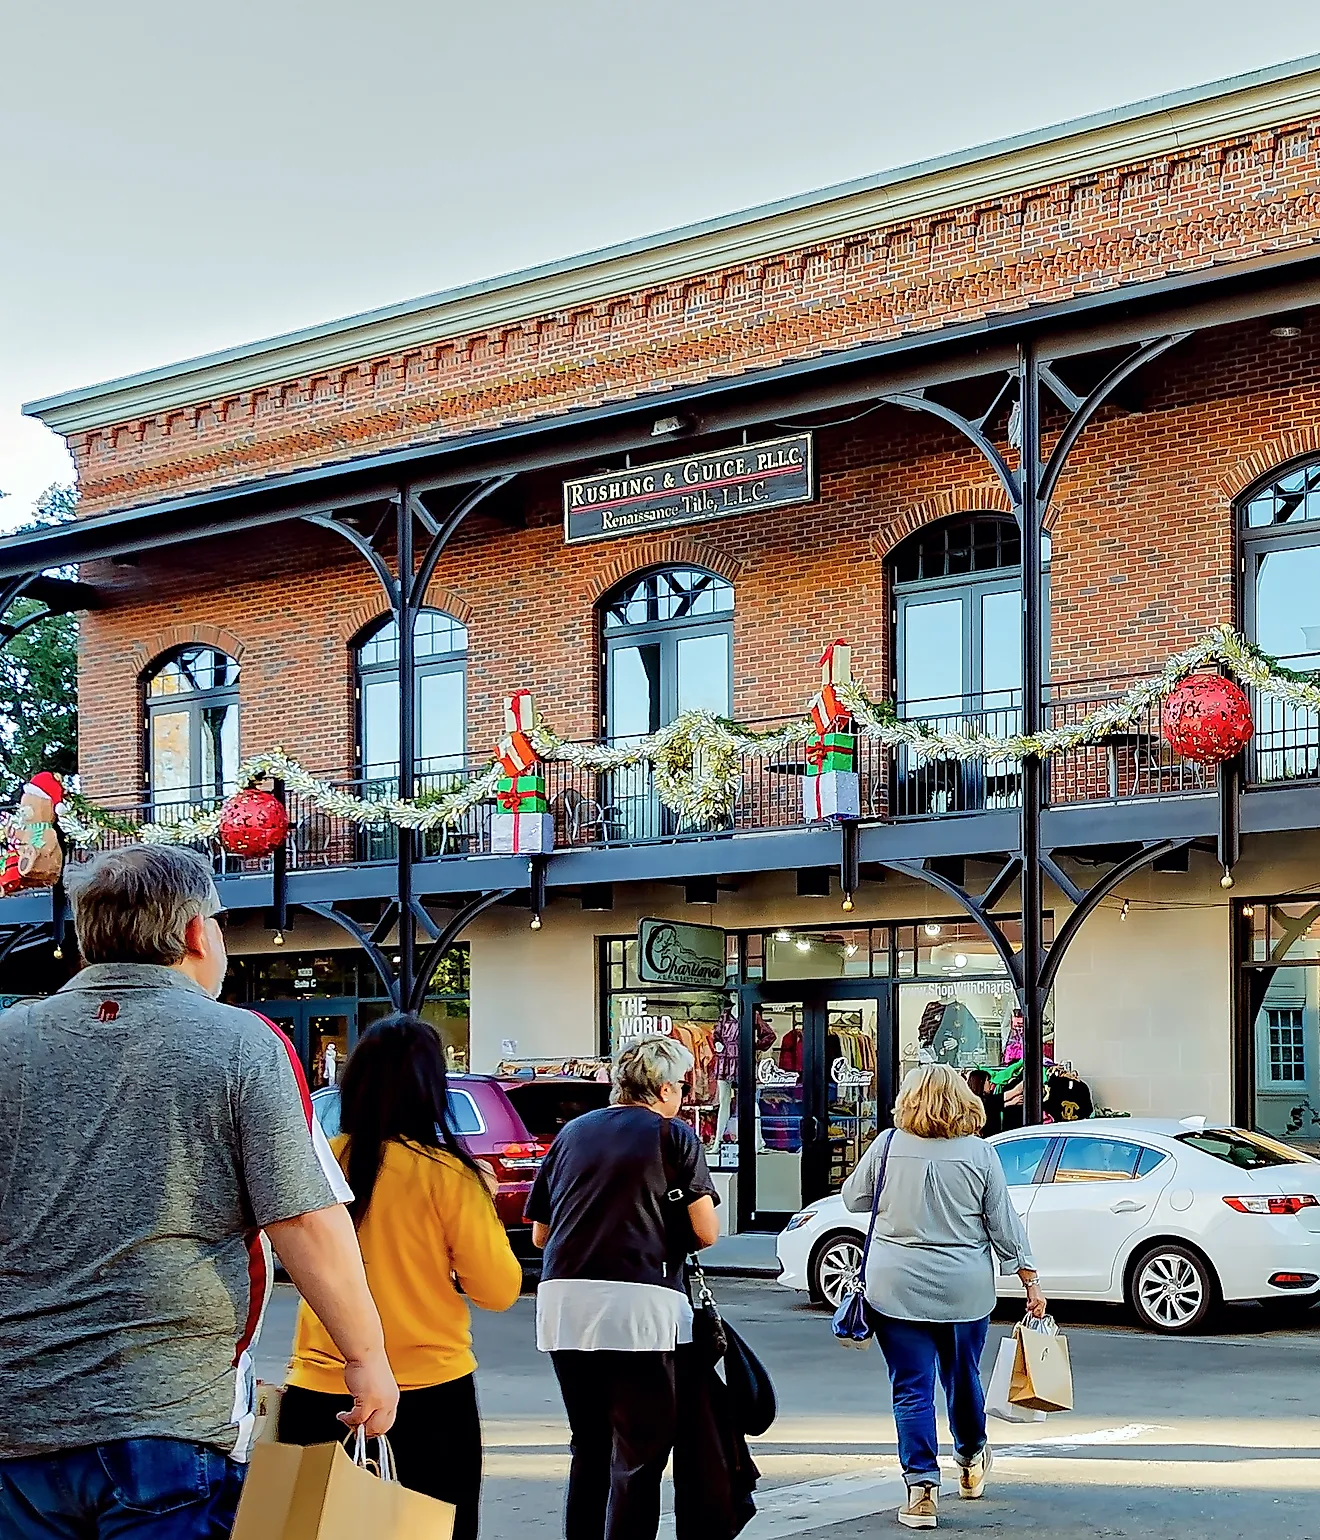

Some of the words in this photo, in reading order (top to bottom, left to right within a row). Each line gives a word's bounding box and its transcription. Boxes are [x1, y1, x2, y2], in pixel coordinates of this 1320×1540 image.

[662, 472, 676, 488] &
[601, 504, 679, 530] Renaissance
[682, 491, 719, 514] Title,
[723, 481, 769, 507] L.L.C.
[618, 996, 648, 1016] THE
[619, 1015, 673, 1036] WORLD
